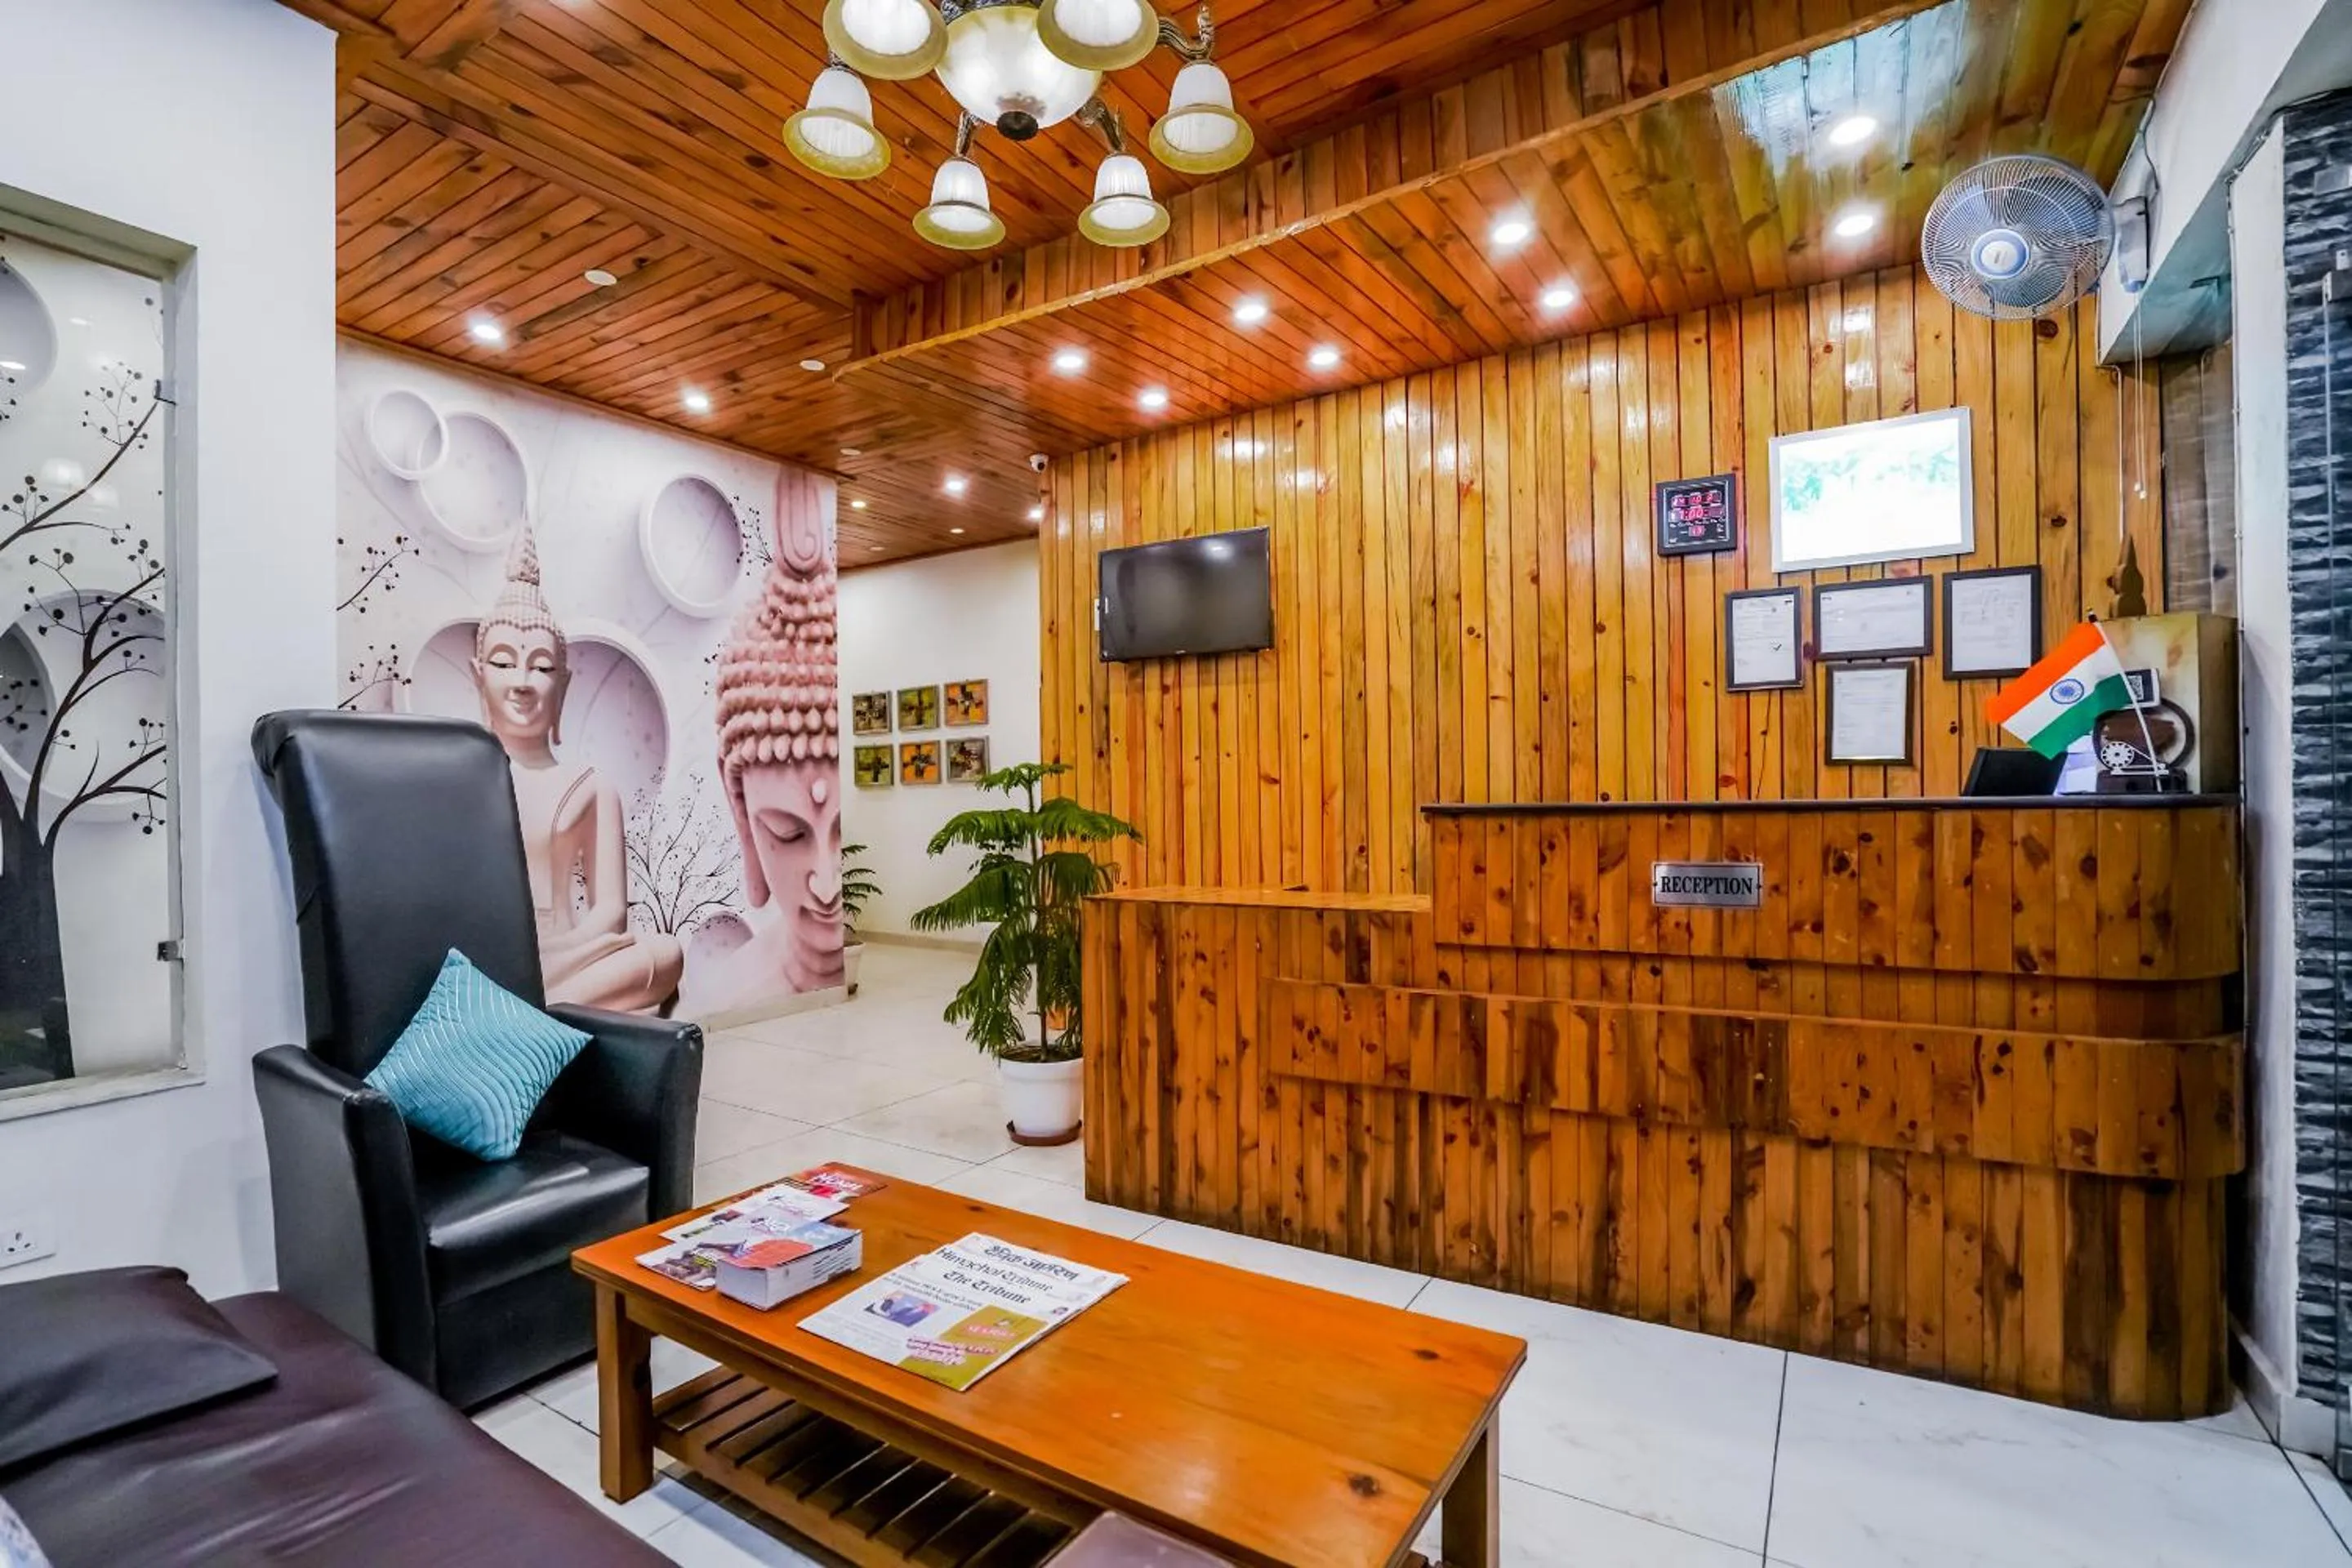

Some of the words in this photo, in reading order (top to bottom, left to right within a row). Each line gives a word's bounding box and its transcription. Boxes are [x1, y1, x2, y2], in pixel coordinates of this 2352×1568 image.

[1660, 875, 1753, 895] RECEPTION
[937, 1247, 1003, 1276] Himachal
[1002, 1270, 1053, 1291] Tribune
[943, 1271, 972, 1285] The
[972, 1279, 1031, 1304] Tribune
